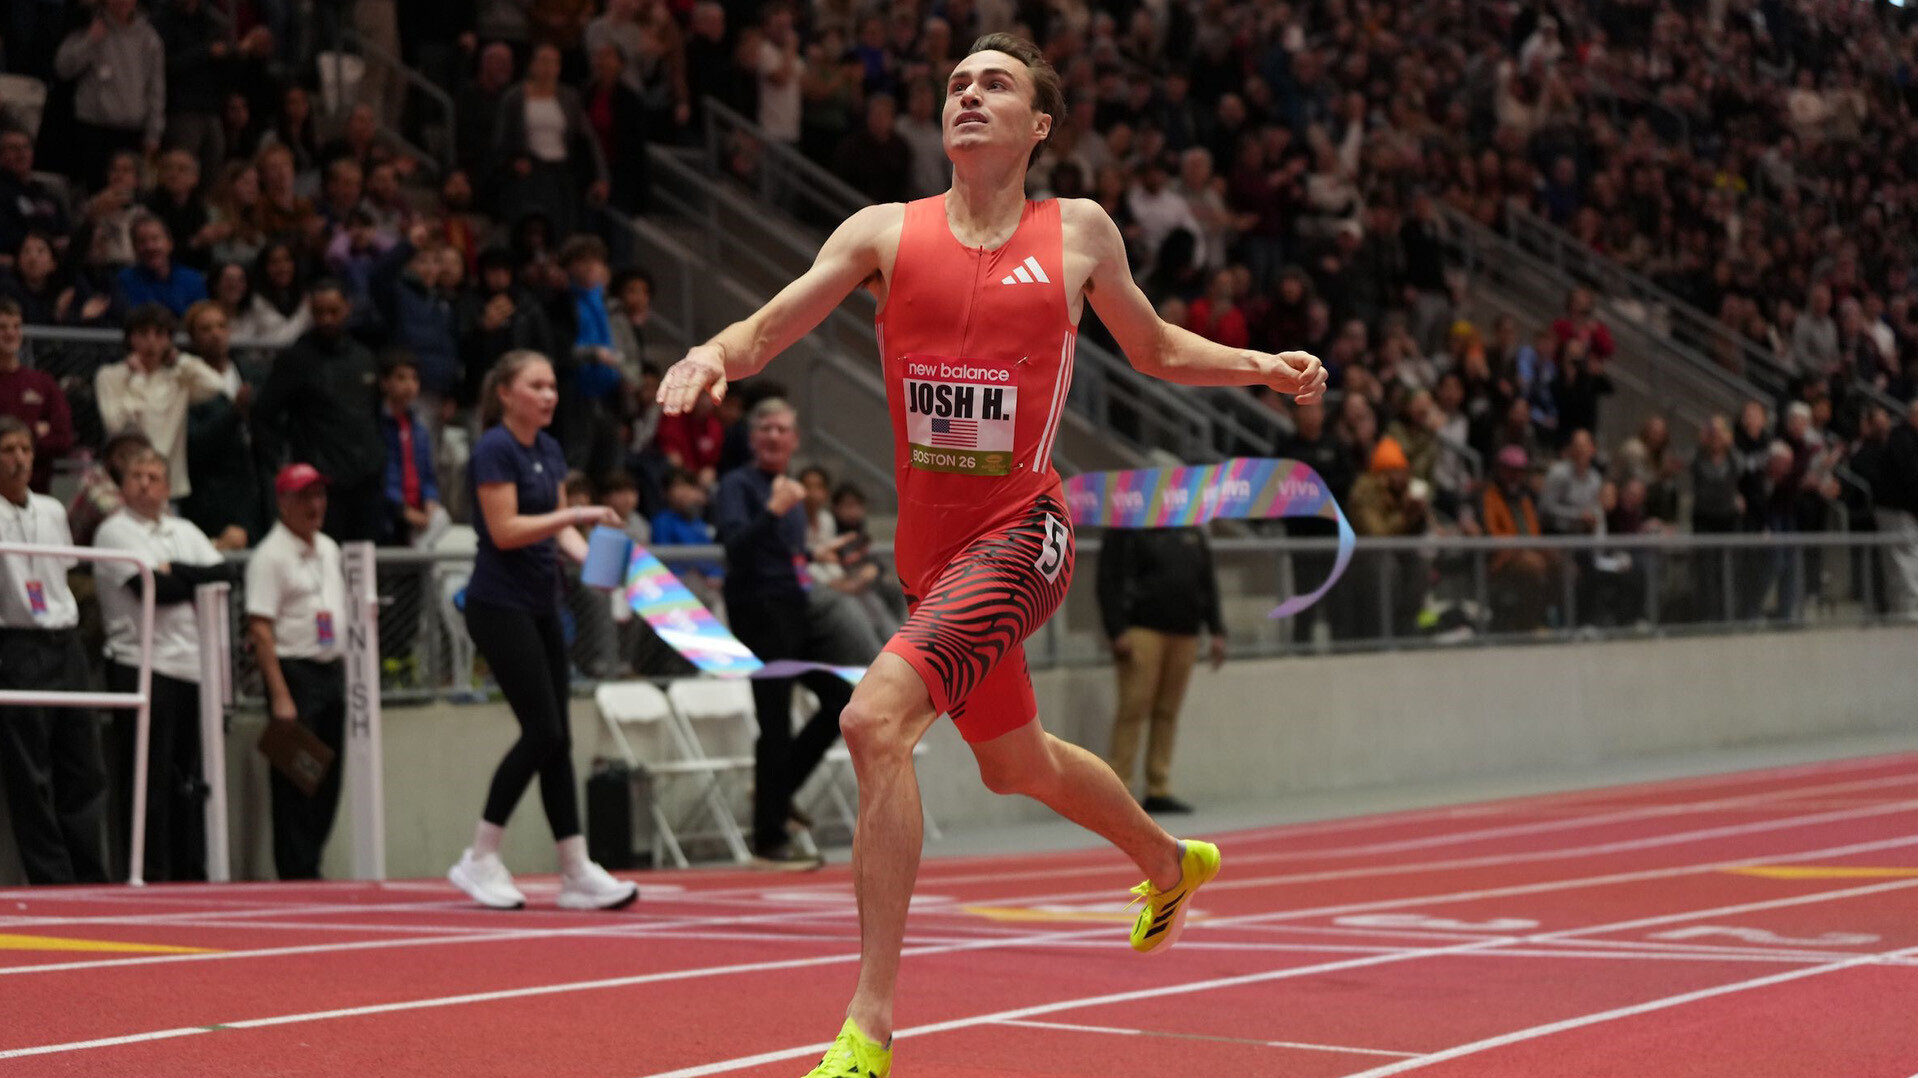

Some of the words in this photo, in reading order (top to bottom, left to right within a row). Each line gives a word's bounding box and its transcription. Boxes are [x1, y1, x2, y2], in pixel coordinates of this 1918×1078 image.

[909, 362, 937, 377] new
[940, 362, 1010, 381] balance
[909, 381, 974, 418] JOSH
[982, 387, 1010, 421] H.
[912, 449, 956, 467] BOSTON
[959, 455, 976, 469] 26
[1278, 481, 1319, 497] VIVA
[1041, 521, 1064, 575] 5
[348, 566, 370, 739] FINISH
